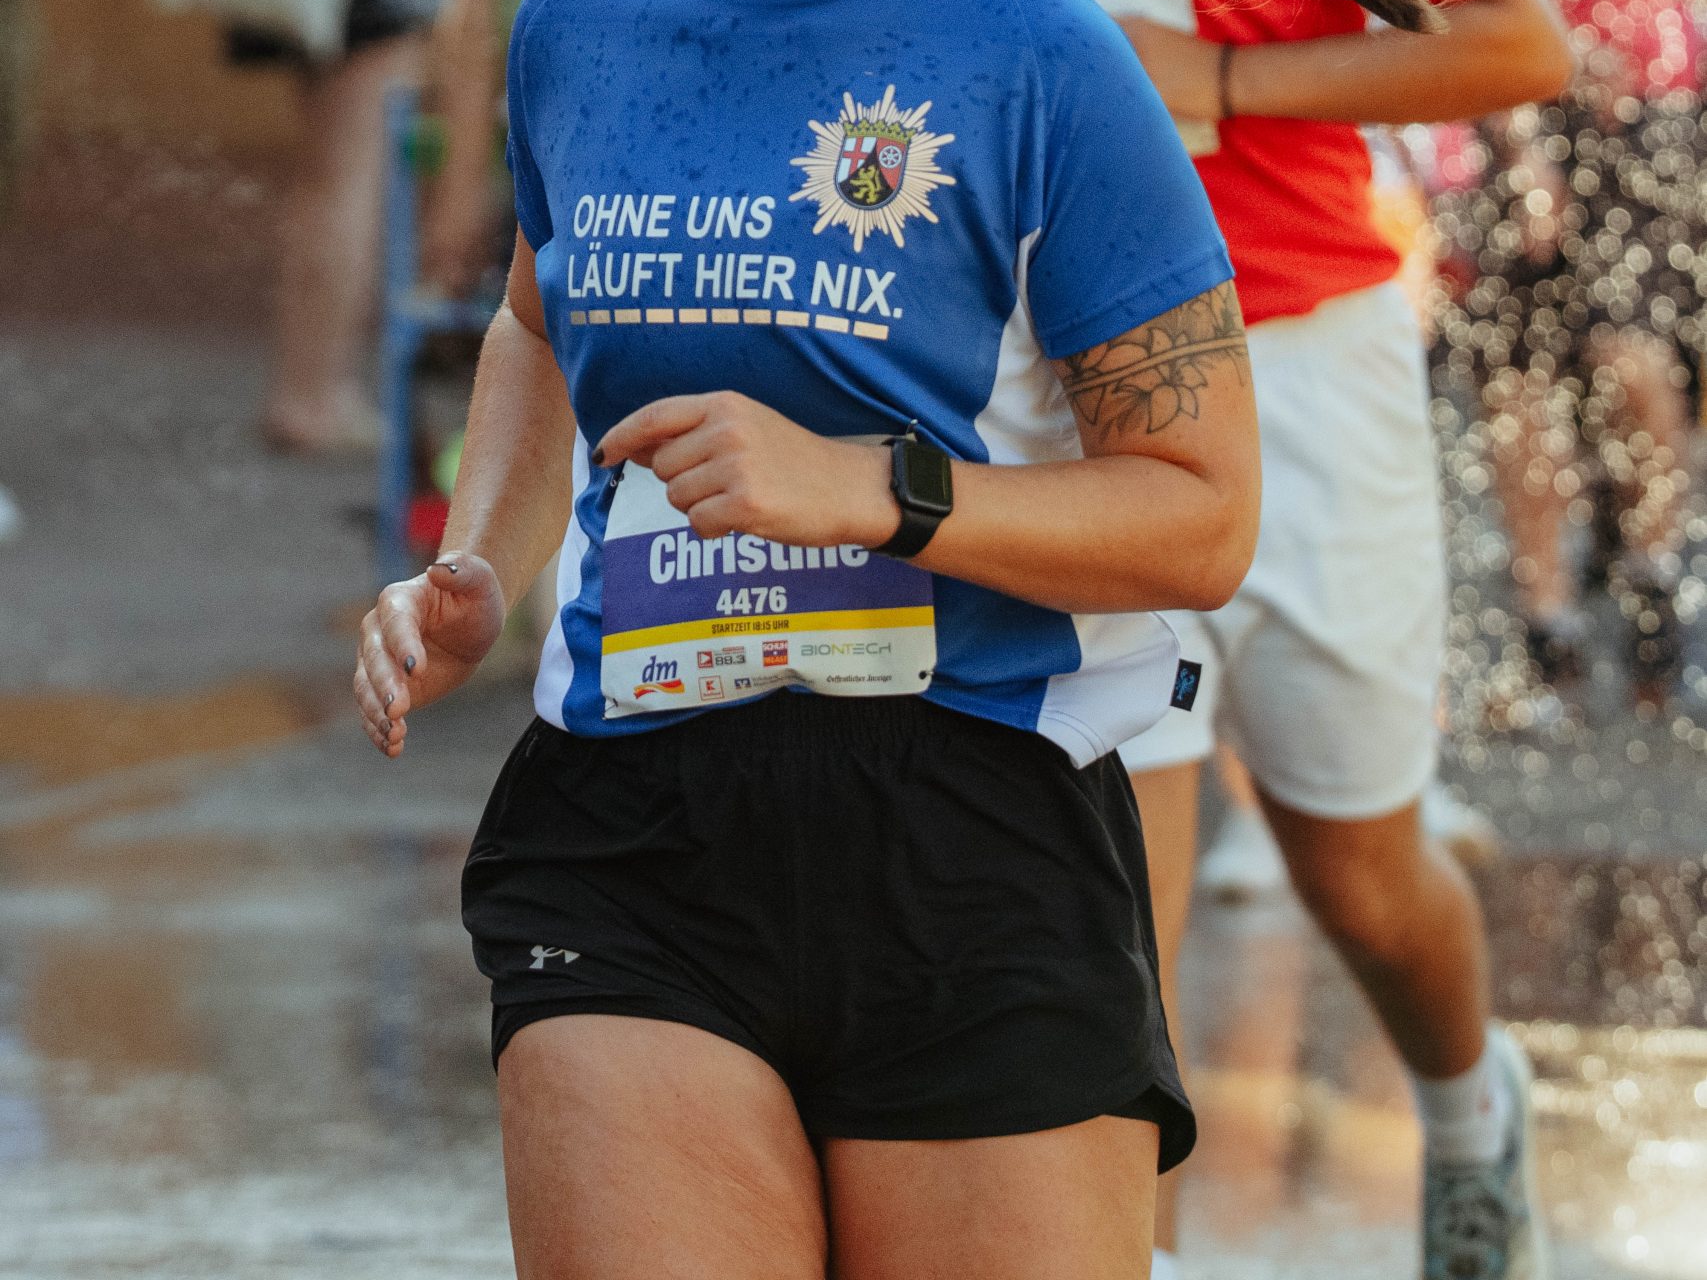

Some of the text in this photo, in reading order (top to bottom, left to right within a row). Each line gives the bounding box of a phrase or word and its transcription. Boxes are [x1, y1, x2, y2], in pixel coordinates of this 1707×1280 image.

[573, 194, 776, 239] OHNE UNS
[568, 242, 904, 319] LÄUFT HIER NIX.
[716, 586, 788, 615] 4476
[711, 619, 790, 634] STARTZEIT 18:15 UHR
[801, 642, 892, 656] BIONTECH
[641, 655, 678, 683] dm
